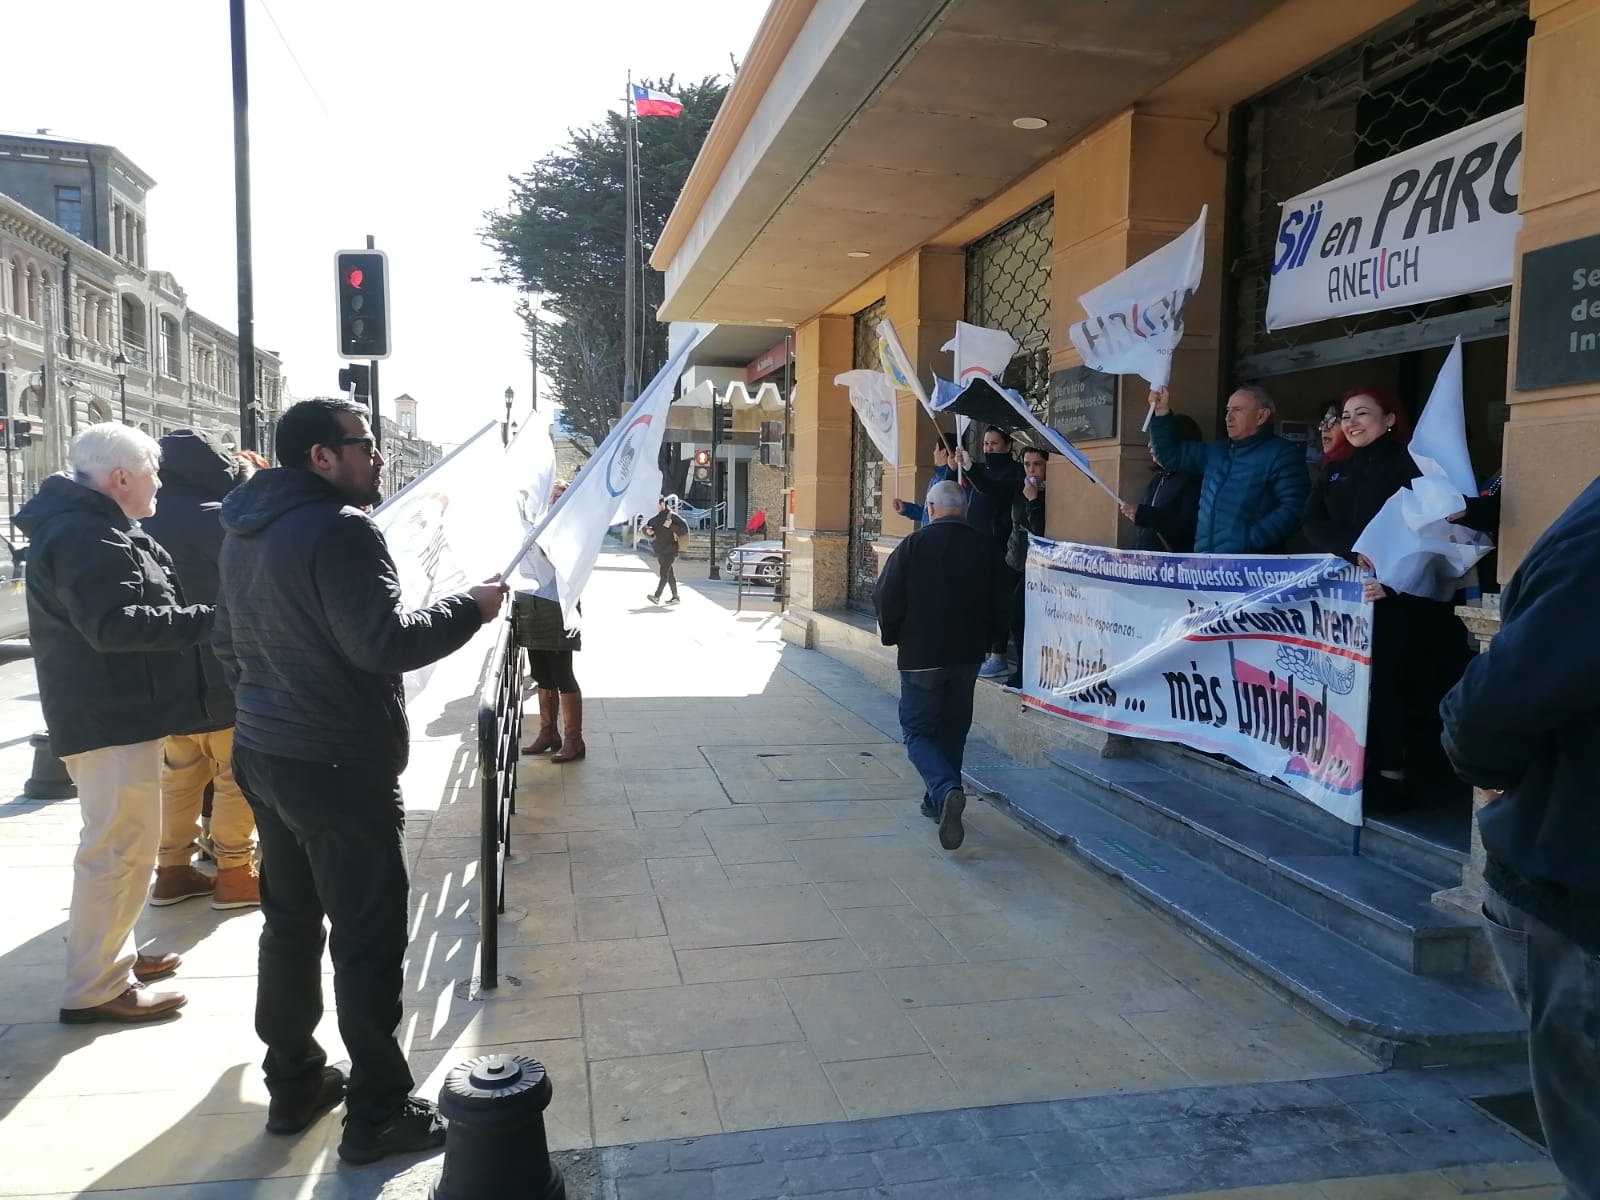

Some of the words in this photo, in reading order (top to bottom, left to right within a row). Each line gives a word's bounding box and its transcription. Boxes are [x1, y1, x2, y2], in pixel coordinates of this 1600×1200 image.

[1320, 216, 1363, 258] en
[1569, 331, 1600, 353] In
[1055, 382, 1086, 398] Servicio
[1065, 394, 1107, 413] Impuestos
[1099, 558, 1158, 582] Funcionarios
[1160, 561, 1174, 583] de
[1177, 565, 1244, 590] Impuestos
[1243, 566, 1301, 589] Interno
[1310, 600, 1370, 650] Arenas
[1232, 670, 1328, 766] unidad
